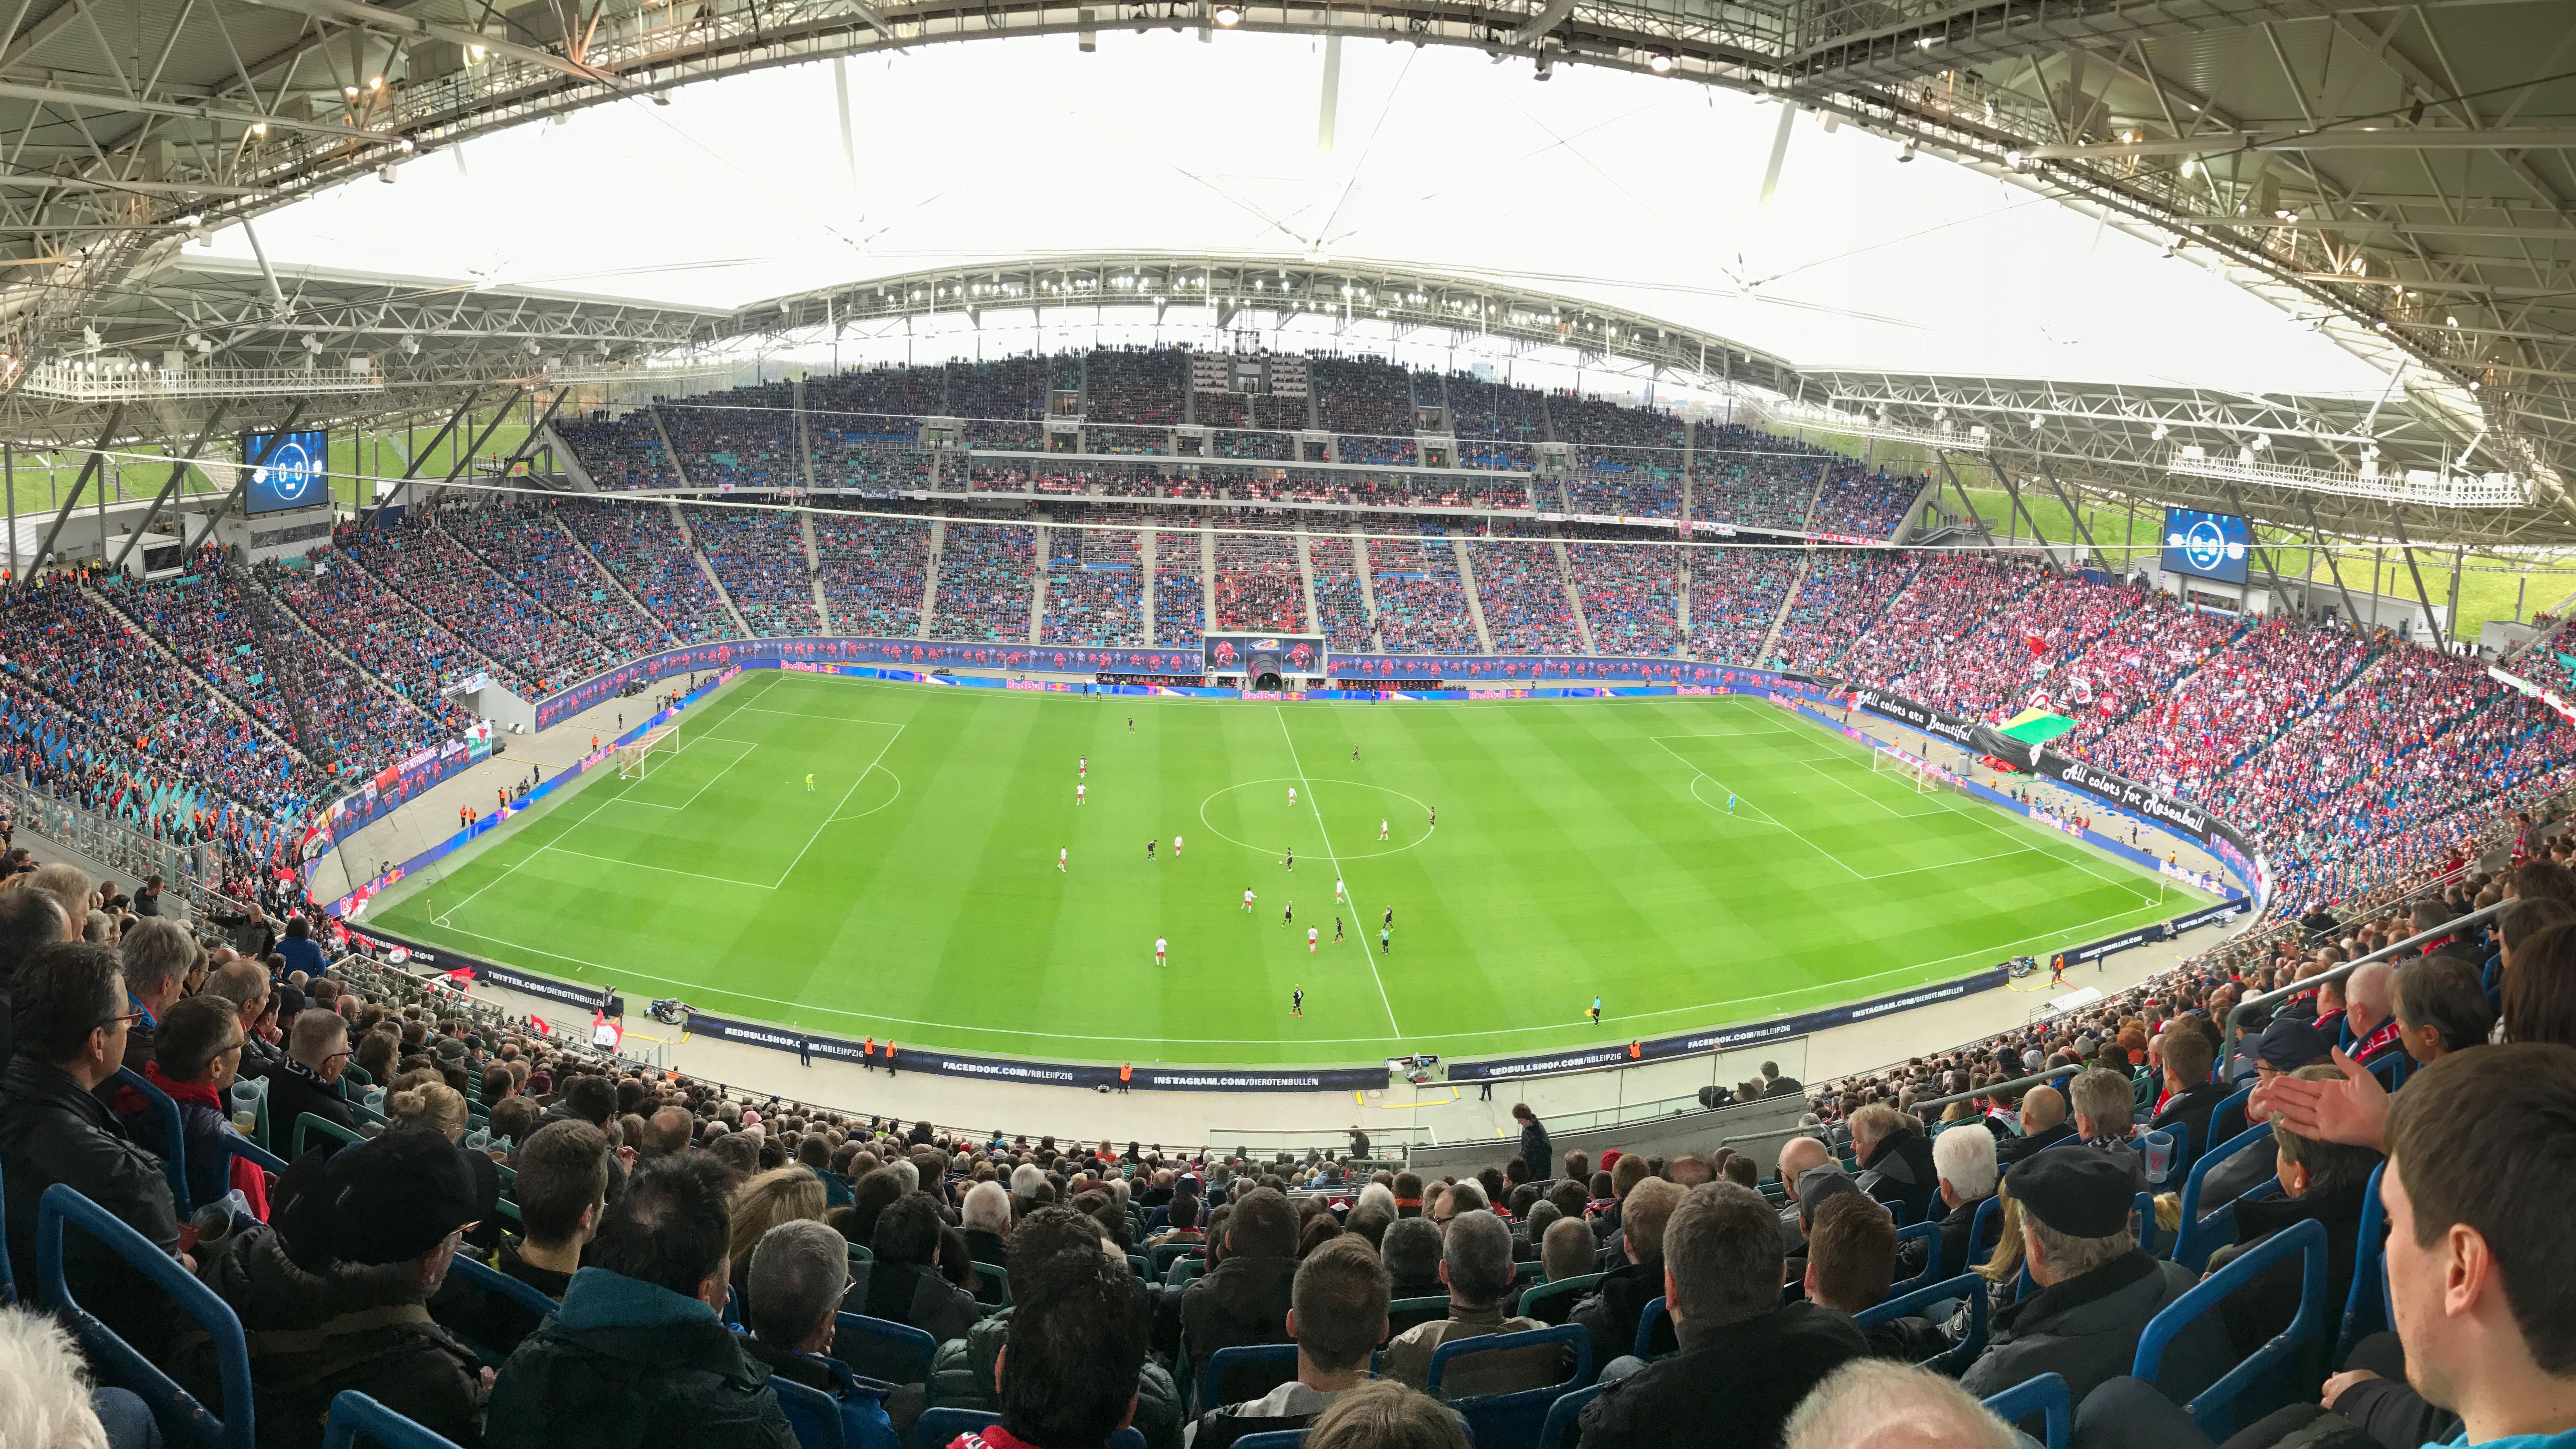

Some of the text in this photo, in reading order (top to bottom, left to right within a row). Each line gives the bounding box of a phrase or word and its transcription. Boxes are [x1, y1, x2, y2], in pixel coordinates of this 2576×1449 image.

[1823, 534, 1874, 545] LIPSIA
[781, 660, 817, 672] Red Bull
[1007, 679, 1045, 690] Red Bull
[1242, 690, 1281, 700] Red Bull
[1469, 690, 1506, 699] Red Bull
[1677, 686, 1711, 694] Red Bull
[1862, 691, 1973, 741] All colors are Beautiful
[582, 748, 605, 772] Red Bull
[2063, 764, 2205, 832] All colors for Rasenball
[2029, 807, 2063, 830] Red Bull
[2160, 860, 2202, 888] Red Bull
[488, 970, 605, 1007] TWITTER.COM/DIEROTENBULLEN
[1852, 986, 1964, 1018] INSTAGRAM.COM/DIEROTENBULLEN
[725, 1027, 864, 1058] REDBULLSHOP.CM/RBLEIPZIG
[1688, 1025, 1791, 1049] FACEBOOK.COM/RBLEIPZIG
[943, 1061, 1073, 1080] FACEBOOK.COM/RBLEIPZIG
[1489, 1052, 1622, 1076] REDBULLSHOP.COM/RBLEIPZIG
[1154, 1076, 1319, 1086] INSTAGRAM.COM/DIEROTENBULLEN
